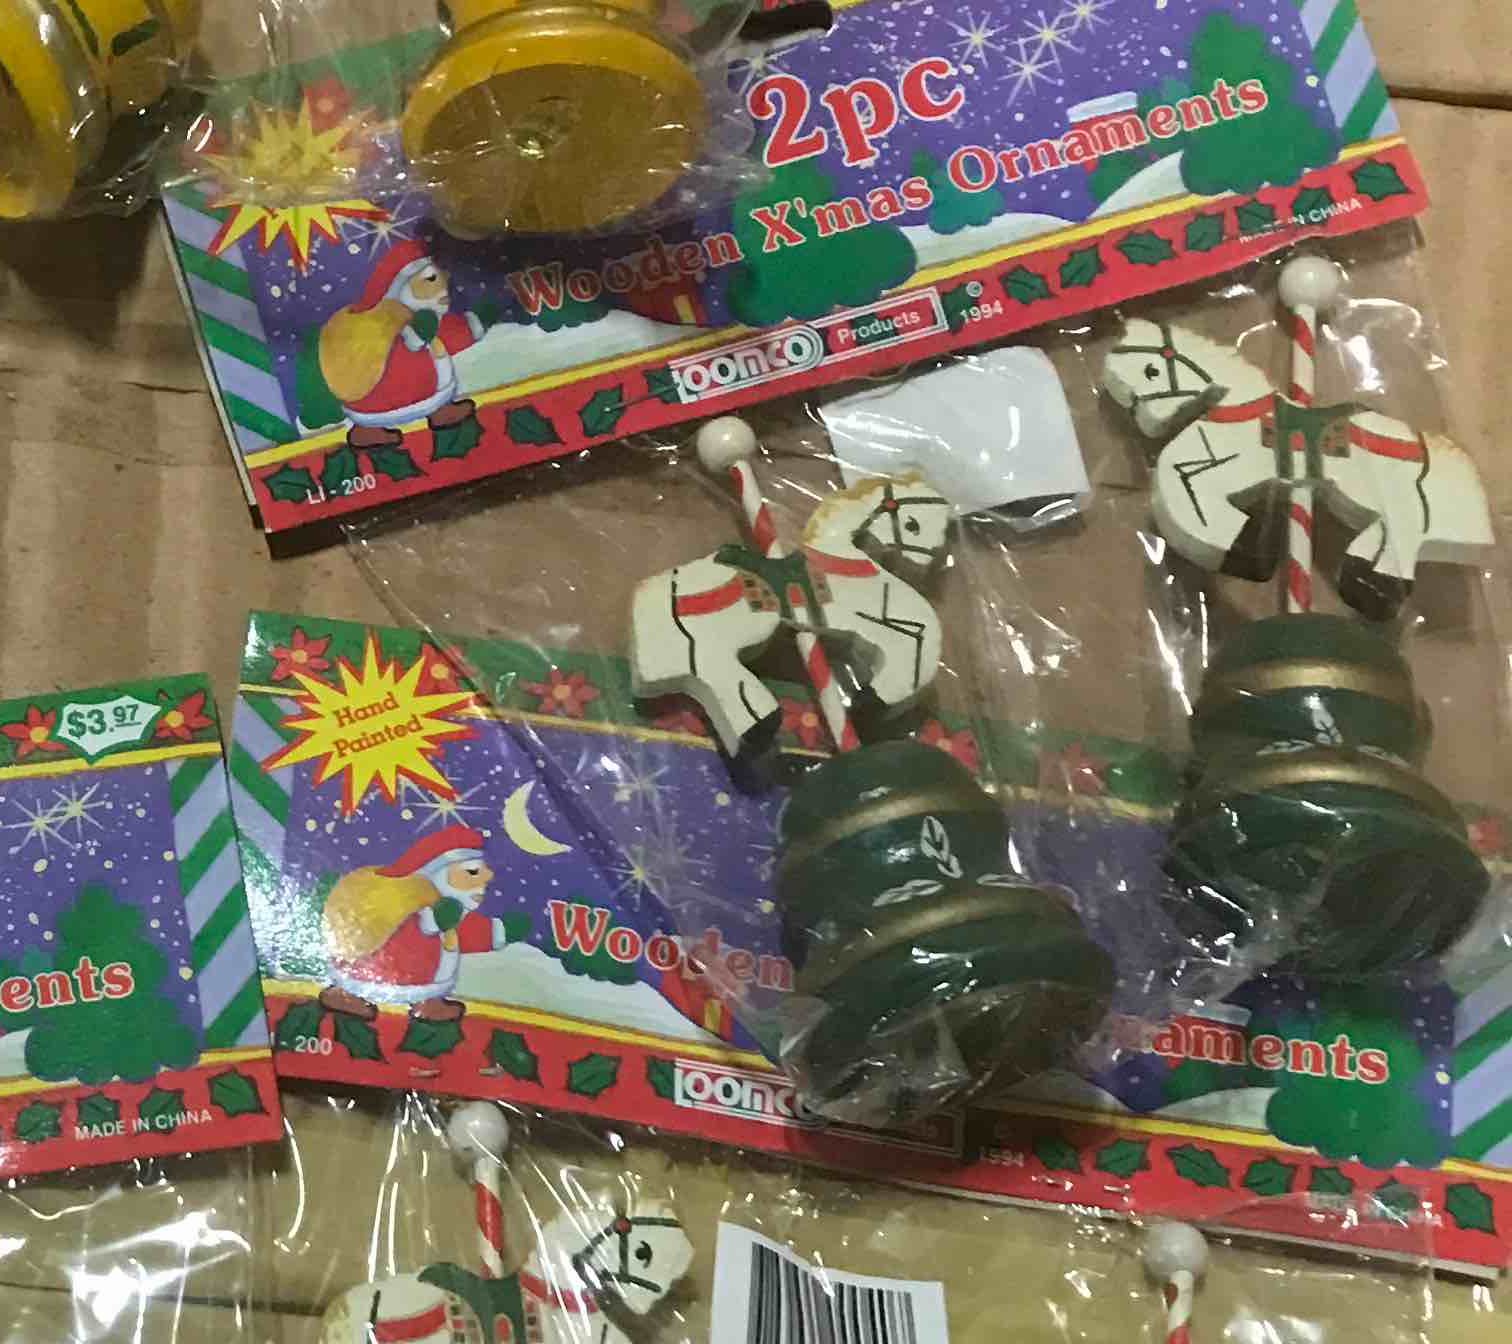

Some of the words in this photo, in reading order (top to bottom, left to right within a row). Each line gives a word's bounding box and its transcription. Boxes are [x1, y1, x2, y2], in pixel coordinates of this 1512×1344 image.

[746, 55, 966, 169] 2pc
[509, 230, 743, 315] Wooden
[750, 175, 934, 253] X'mas
[948, 77, 1269, 193] Ornaments
[1309, 197, 1363, 223] CHINA
[838, 308, 922, 345] Products
[959, 299, 1005, 326] 1994
[341, 473, 377, 497] 200
[67, 703, 139, 739] $3.97
[332, 691, 401, 729] Hand
[332, 713, 425, 759] Painted
[294, 1033, 333, 1056] 200
[1148, 1018, 1391, 1085] aments
[74, 1119, 127, 1141] MADE
[132, 1117, 150, 1133] IN
[155, 1108, 213, 1130] CHINA
